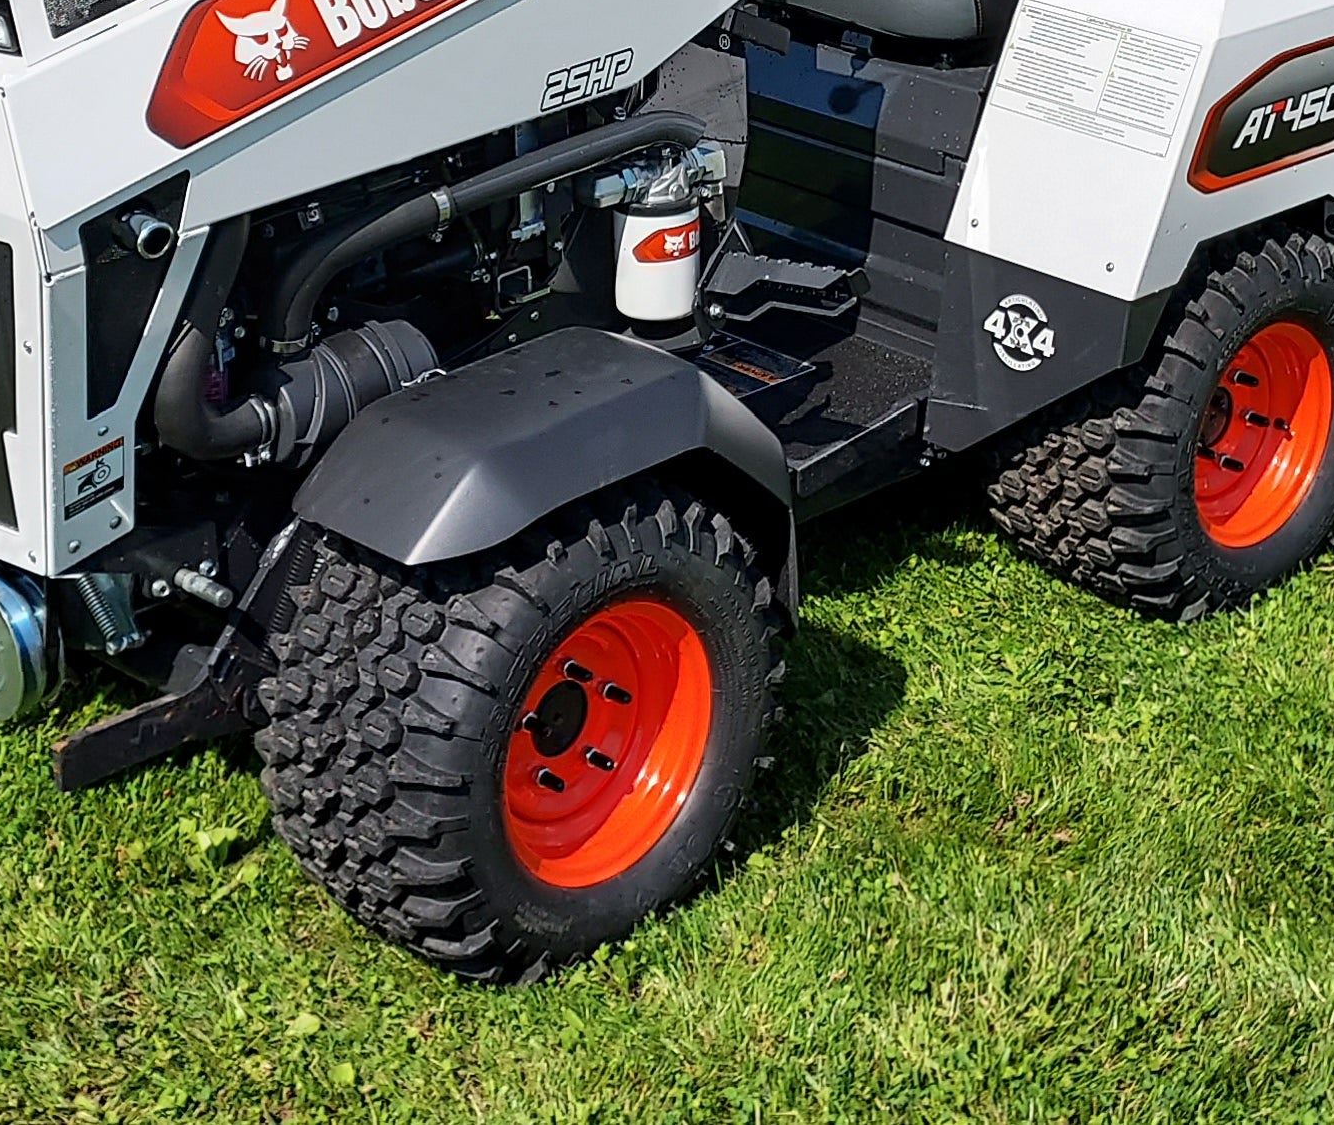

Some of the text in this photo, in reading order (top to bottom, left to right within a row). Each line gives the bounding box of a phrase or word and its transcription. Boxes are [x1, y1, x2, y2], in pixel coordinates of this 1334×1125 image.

[540, 47, 634, 112] 25HP
[1004, 297, 1043, 319] ARTICULATING
[998, 347, 1036, 369] OSCILLATING
